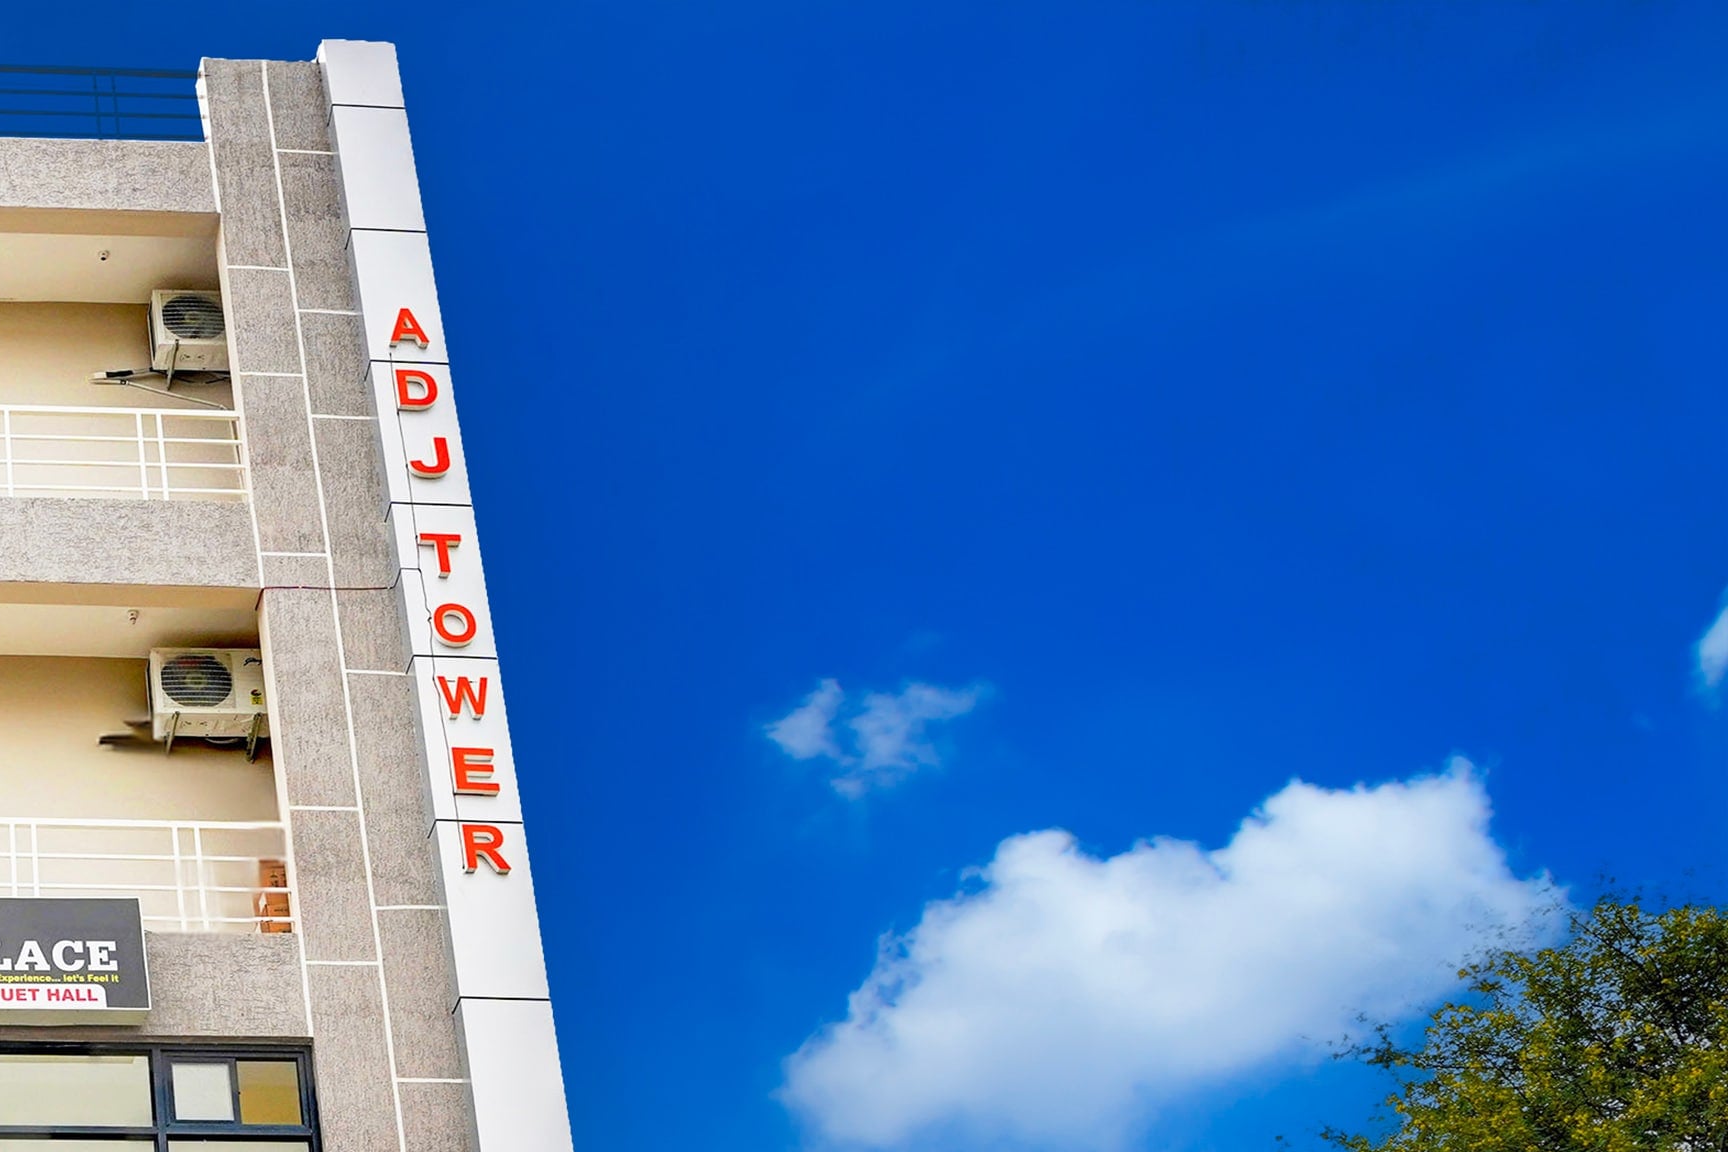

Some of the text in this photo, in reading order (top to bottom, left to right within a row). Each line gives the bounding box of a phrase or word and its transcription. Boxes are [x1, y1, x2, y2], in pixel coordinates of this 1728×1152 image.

[389, 308, 511, 875] ADJ TOWER
[63, 974, 85, 983] let's
[87, 974, 109, 983] Feel
[47, 988, 98, 1002] HALL
